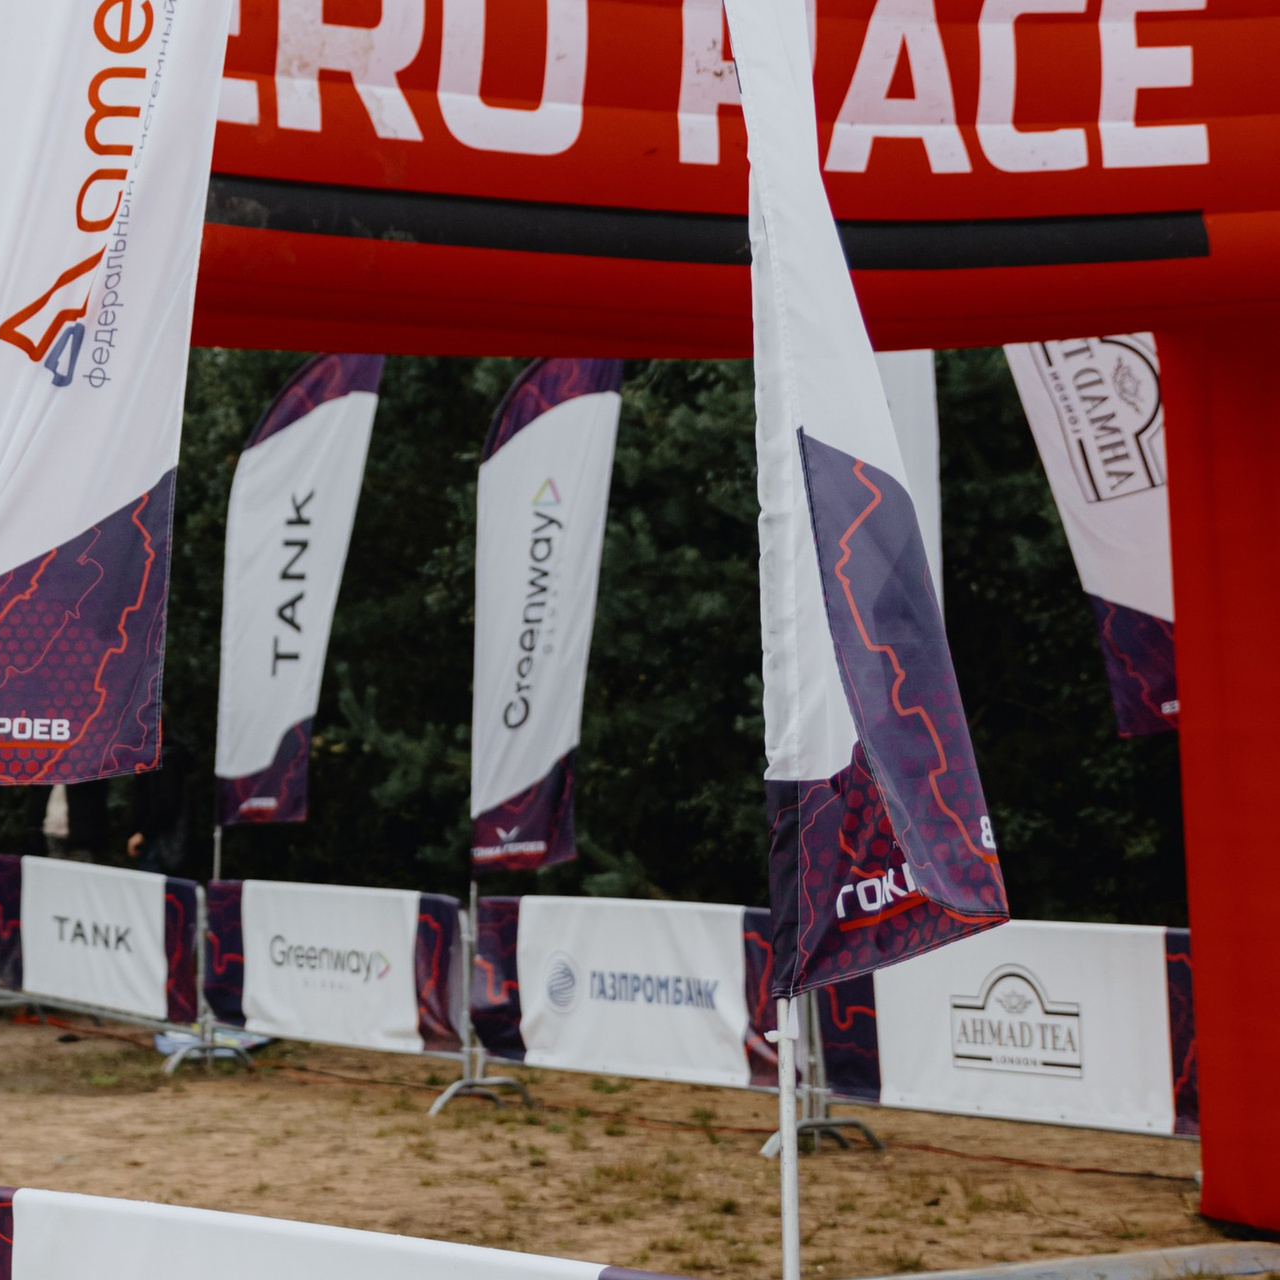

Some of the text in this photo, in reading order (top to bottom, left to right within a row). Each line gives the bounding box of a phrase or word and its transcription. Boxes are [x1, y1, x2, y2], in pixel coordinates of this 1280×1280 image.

[82, 179, 135, 388] федеральный
[271, 489, 315, 677] TANK
[503, 510, 563, 730] Greenway
[53, 915, 133, 953] TANK
[269, 934, 373, 983] Greenway
[590, 970, 718, 1009] ГАЗПРОМБАНК
[957, 1019, 1077, 1052] AHMAD TEA
